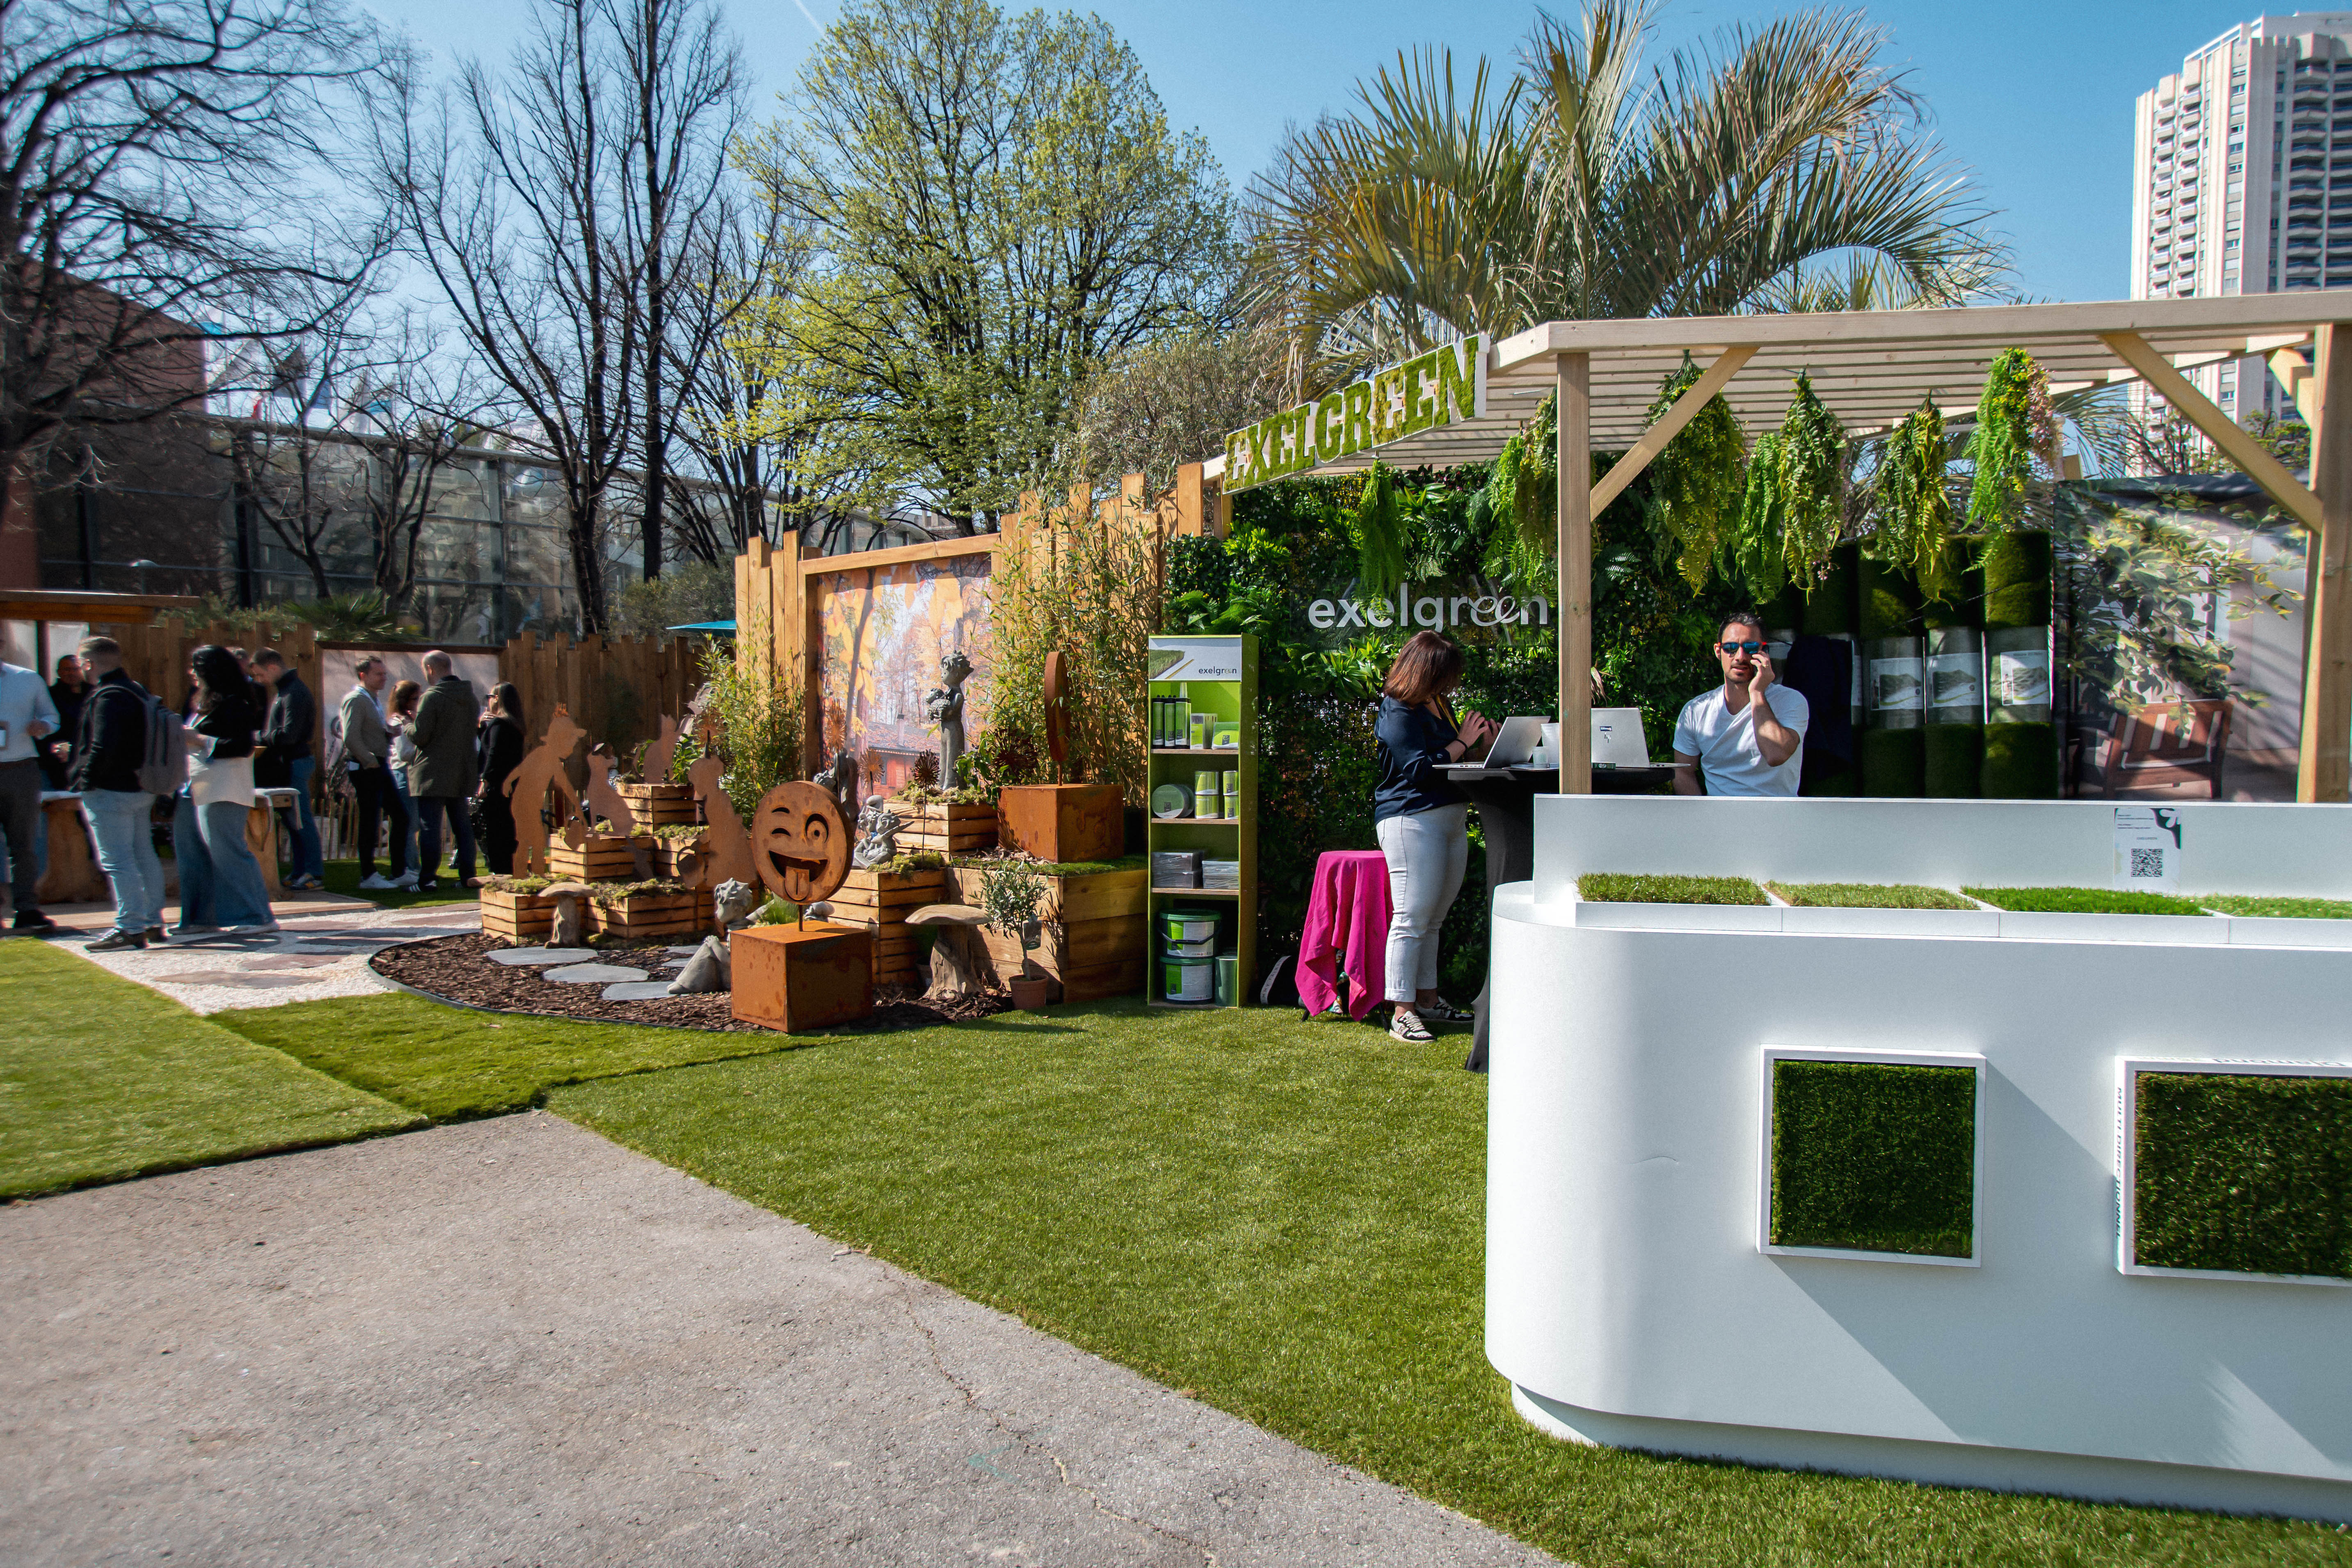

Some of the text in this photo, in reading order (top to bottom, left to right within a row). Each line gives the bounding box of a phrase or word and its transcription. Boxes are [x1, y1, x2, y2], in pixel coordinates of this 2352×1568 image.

[1223, 333, 1490, 495] EXELGREEN
[1308, 582, 1548, 633] exelgreen
[1198, 666, 1237, 676] exelgreen
